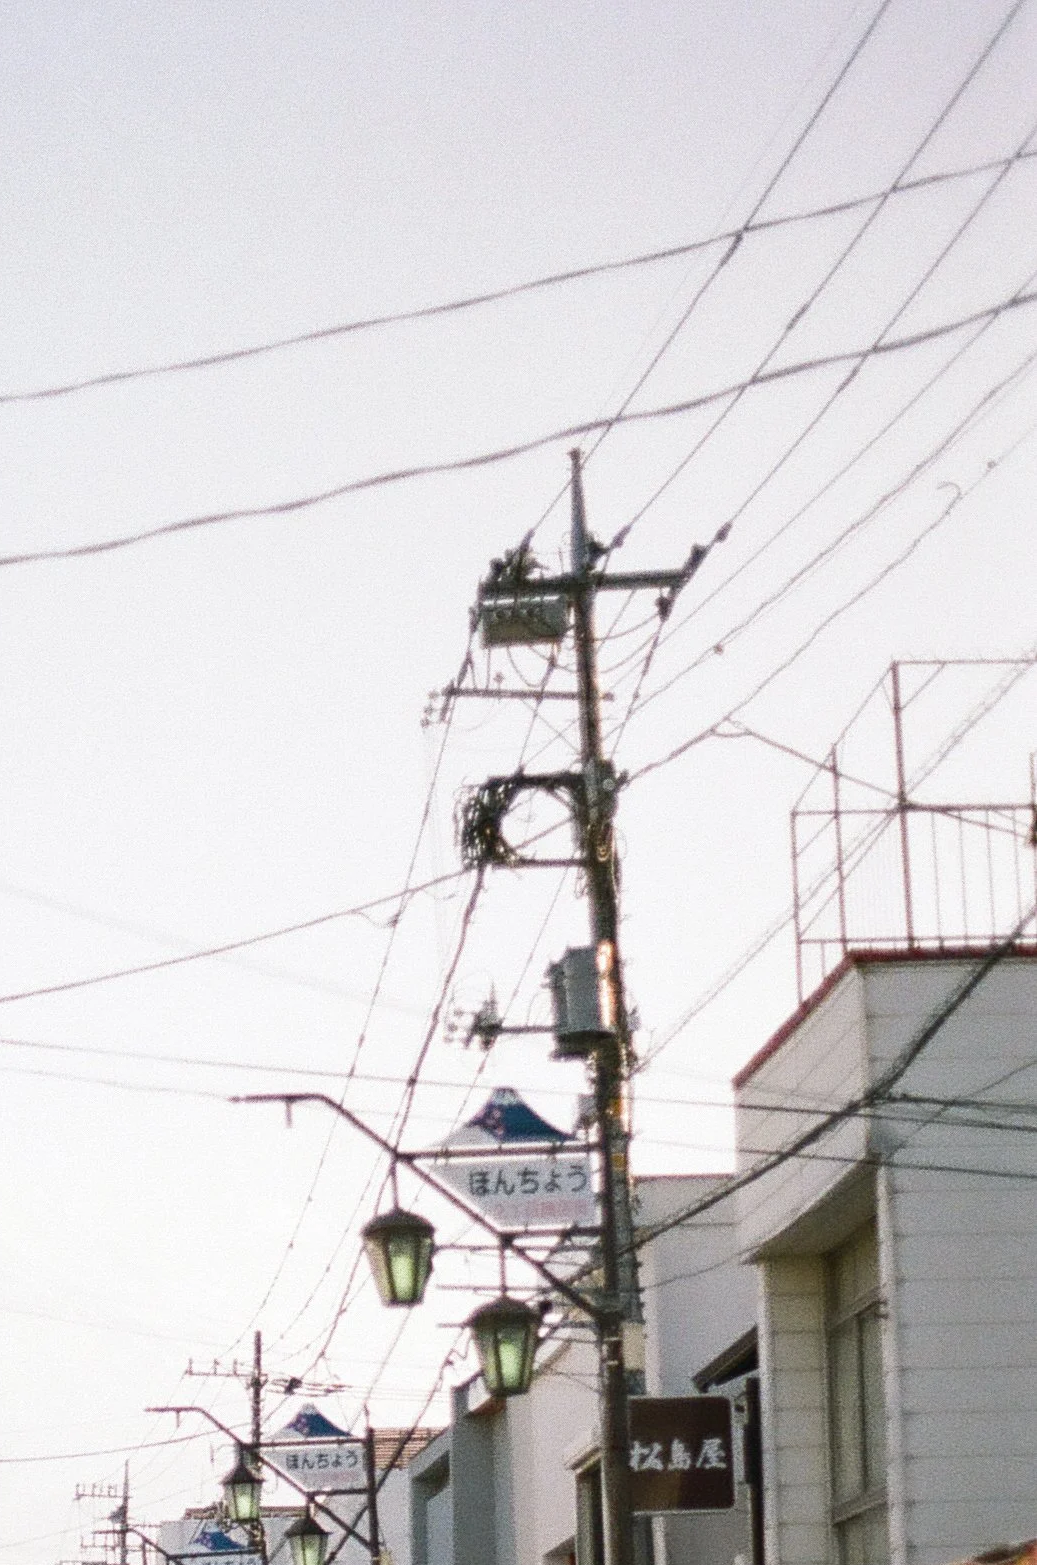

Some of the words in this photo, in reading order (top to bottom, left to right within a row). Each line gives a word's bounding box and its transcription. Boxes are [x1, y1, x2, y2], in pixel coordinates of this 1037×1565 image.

[469, 1164, 588, 1196] ほんちょう
[286, 1450, 358, 1469] ほんちょう
[628, 1438, 727, 1472] 松島屋
